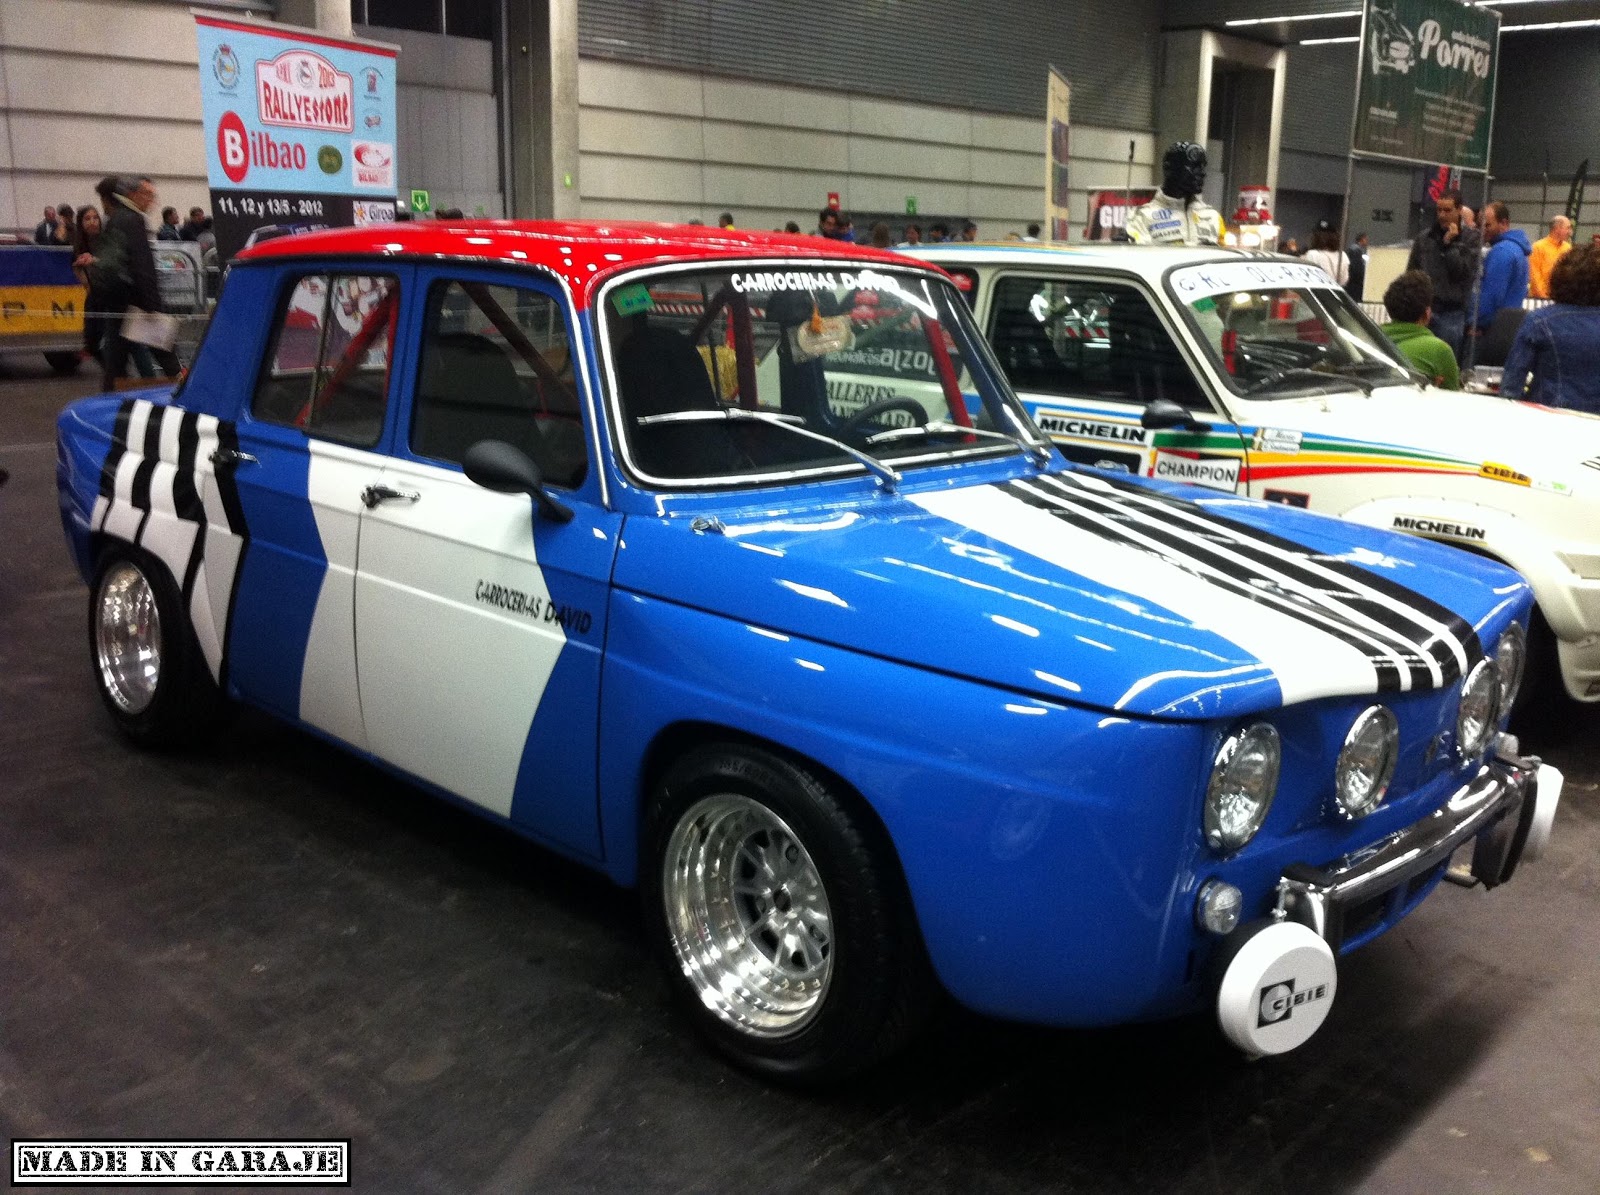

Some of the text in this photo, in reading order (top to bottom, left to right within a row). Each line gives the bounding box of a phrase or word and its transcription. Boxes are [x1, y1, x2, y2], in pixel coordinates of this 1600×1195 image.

[224, 128, 306, 170] Bilbao
[241, 197, 256, 215] 12
[257, 201, 265, 219] y
[731, 271, 837, 293] CARROCERIAS
[1040, 417, 1146, 442] MICHELIN
[1157, 460, 1238, 484] CHAMPION
[1482, 465, 1528, 482] CIBIE
[1393, 516, 1485, 540] MICHELIN
[476, 579, 592, 635] CARROCERIAS DAVID
[1272, 983, 1326, 1011] CIBIE
